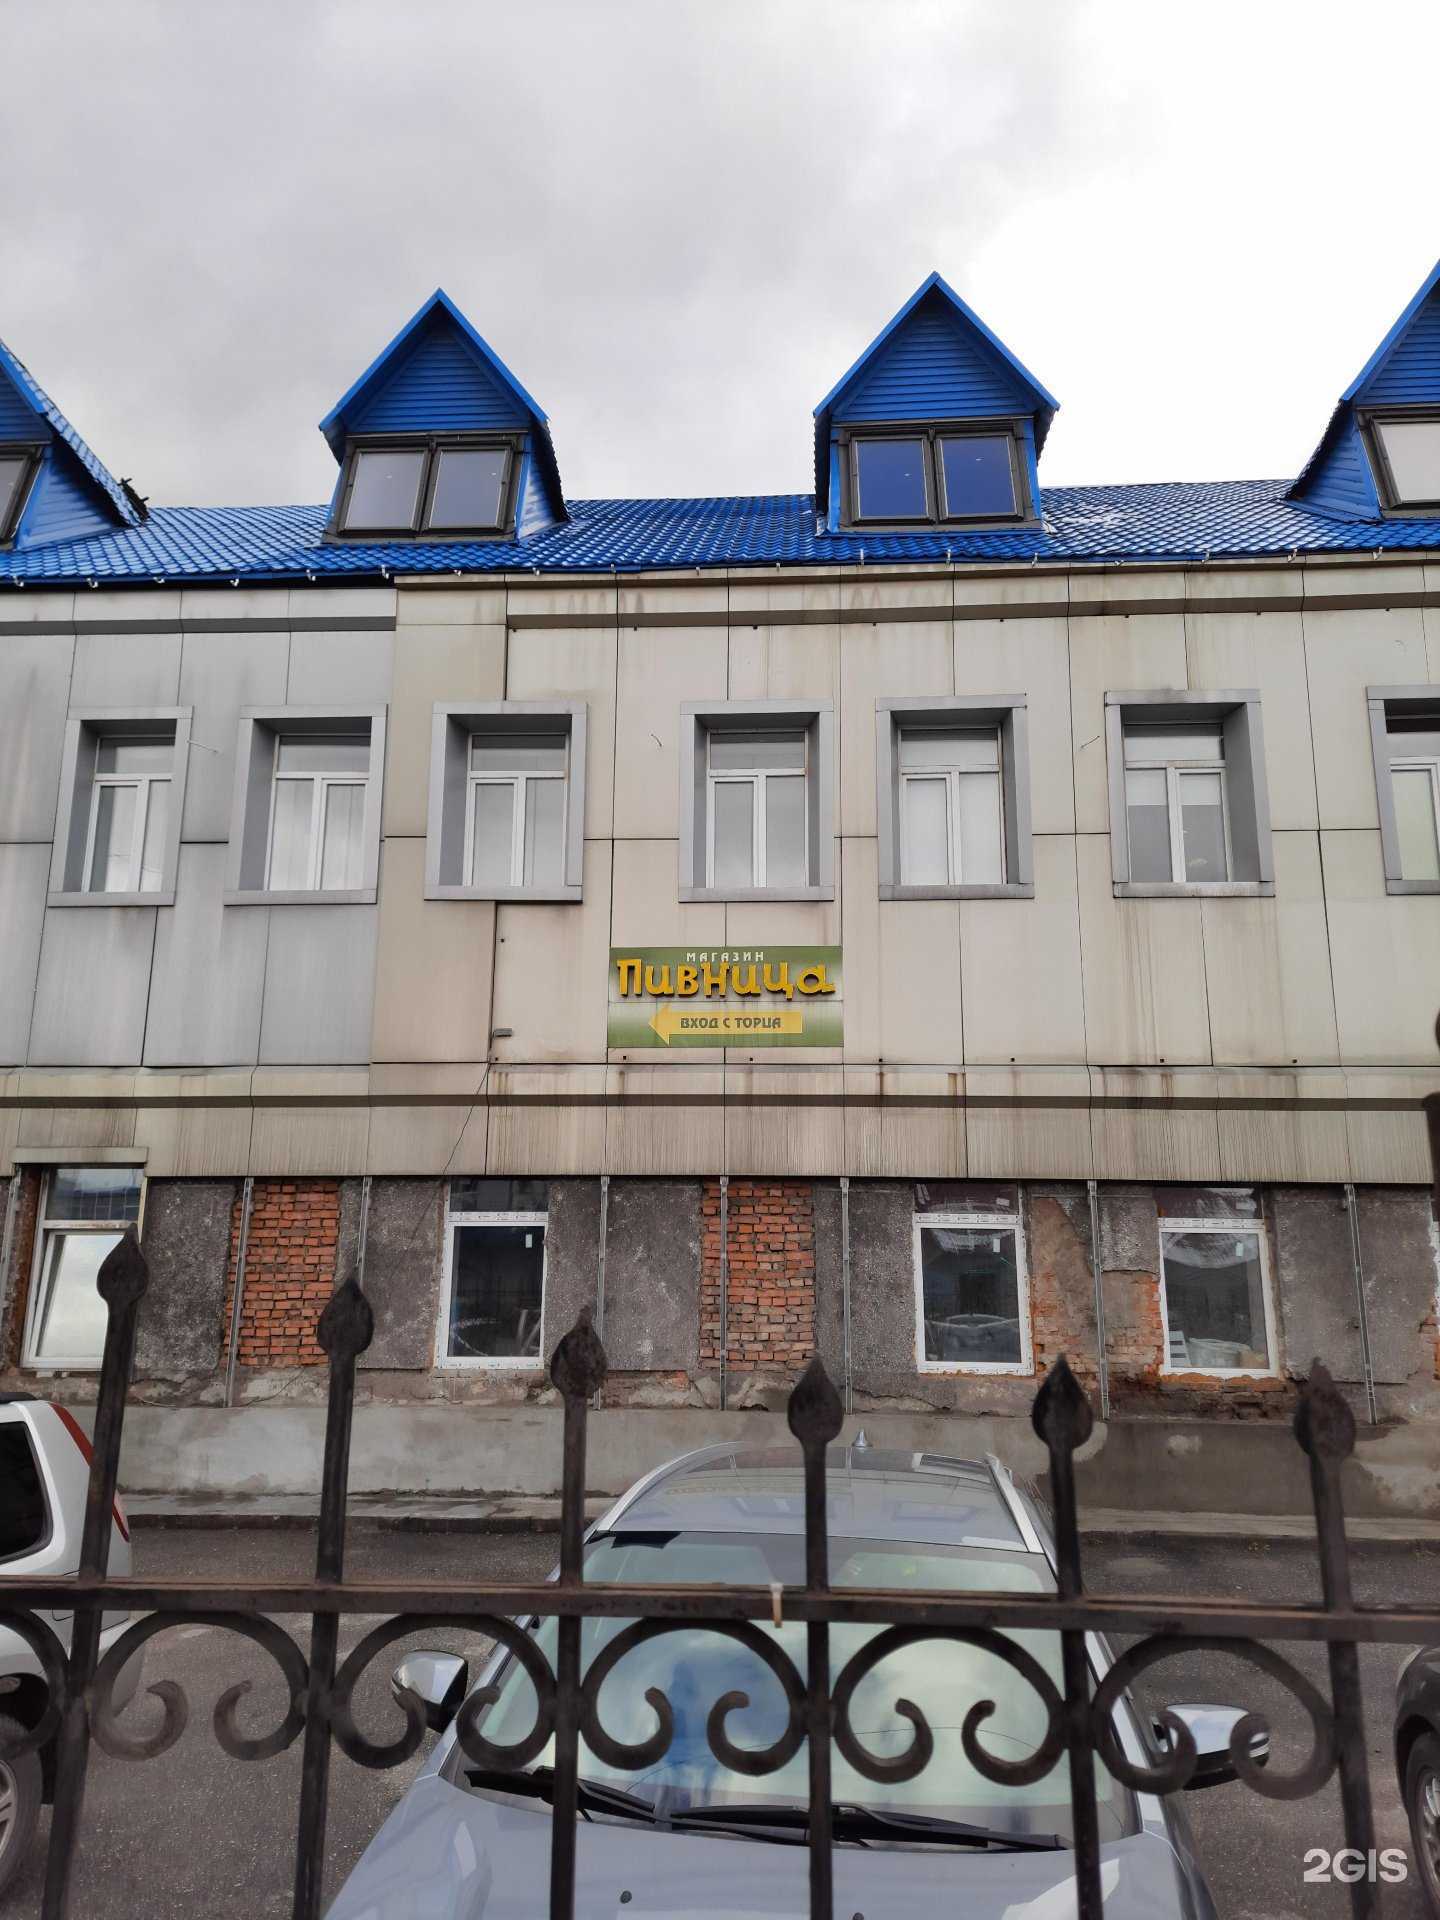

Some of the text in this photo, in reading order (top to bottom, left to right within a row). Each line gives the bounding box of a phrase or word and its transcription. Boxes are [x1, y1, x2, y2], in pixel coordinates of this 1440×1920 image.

[686, 951, 764, 962] МАГАЗИН
[680, 1016, 781, 1029] ВХОД С ТОРЦА
